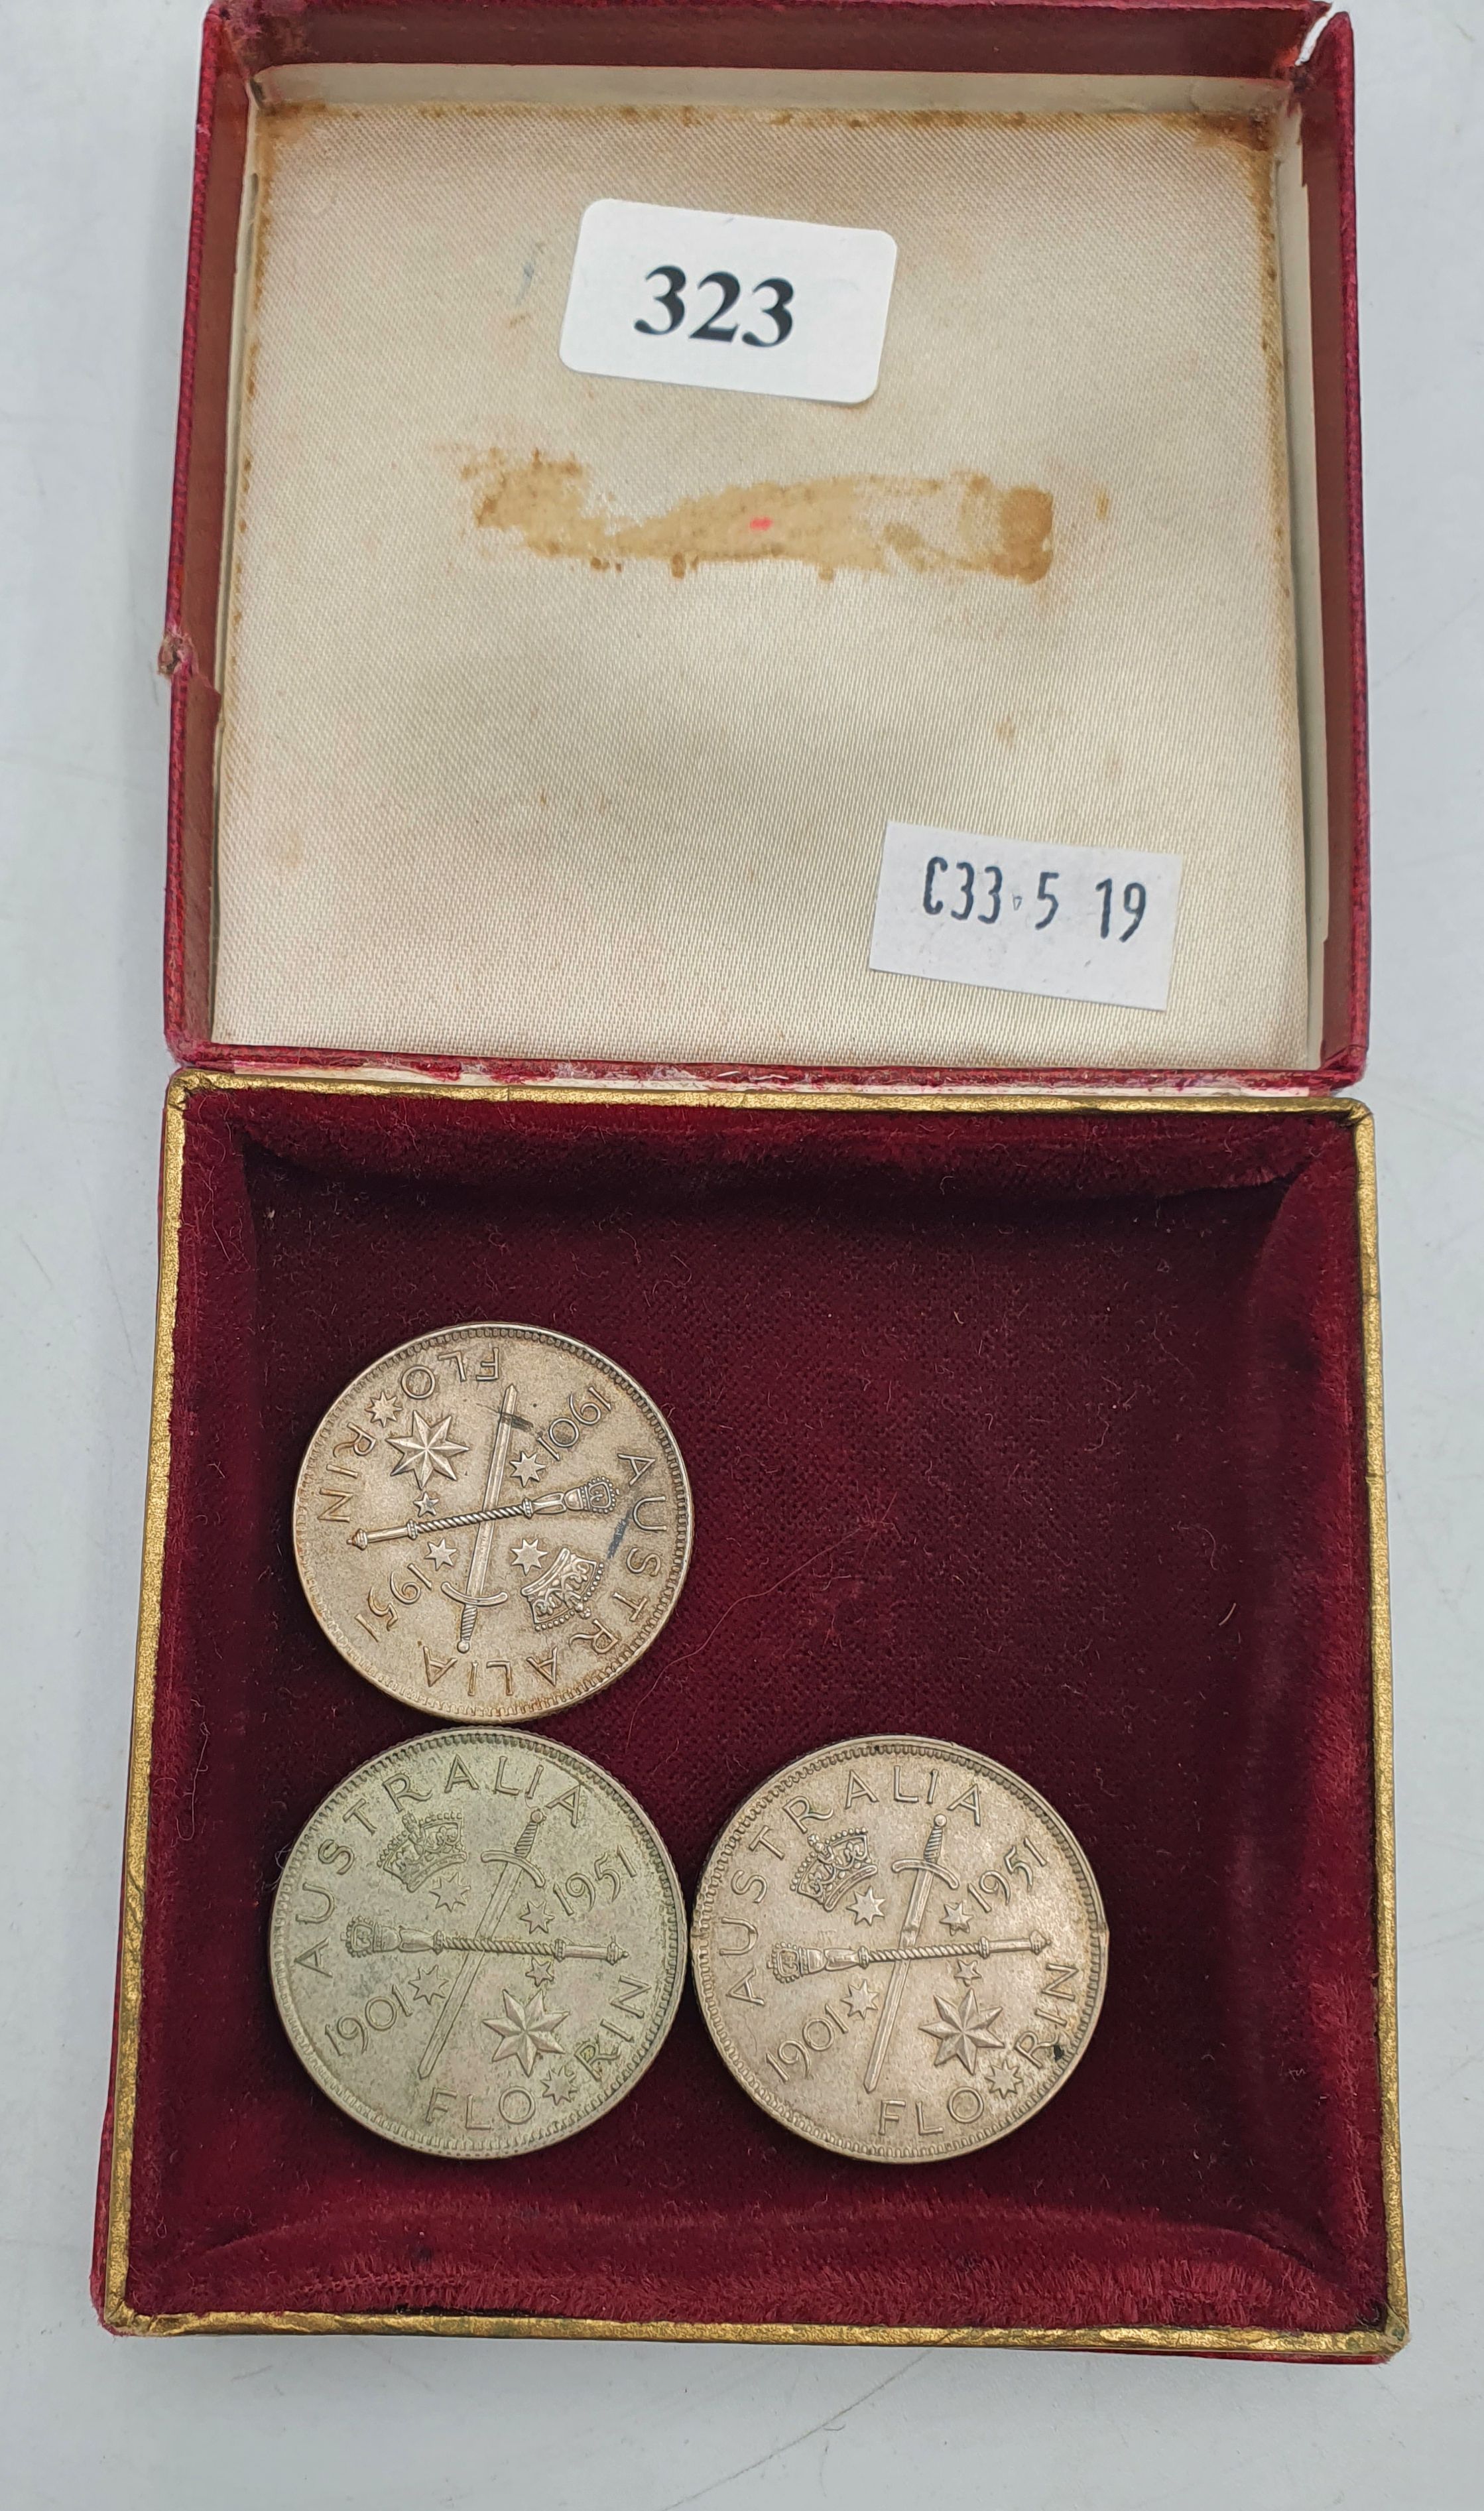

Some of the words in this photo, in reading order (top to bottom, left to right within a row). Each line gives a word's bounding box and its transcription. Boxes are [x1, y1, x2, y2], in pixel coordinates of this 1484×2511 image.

[634, 265, 794, 348] 323
[1095, 877, 1146, 942] 19
[536, 1385, 612, 1460] 1901
[355, 1563, 432, 1642] 1951
[422, 1453, 668, 1697] AUSTRALIA
[294, 1754, 584, 1978] AUSTRALIA
[552, 1844, 637, 1916] 1951
[719, 1766, 981, 2007] AUSTRALIA
[967, 1836, 1048, 1913] 1951
[324, 1984, 413, 2057] 1901
[766, 2004, 849, 2083] 1901
